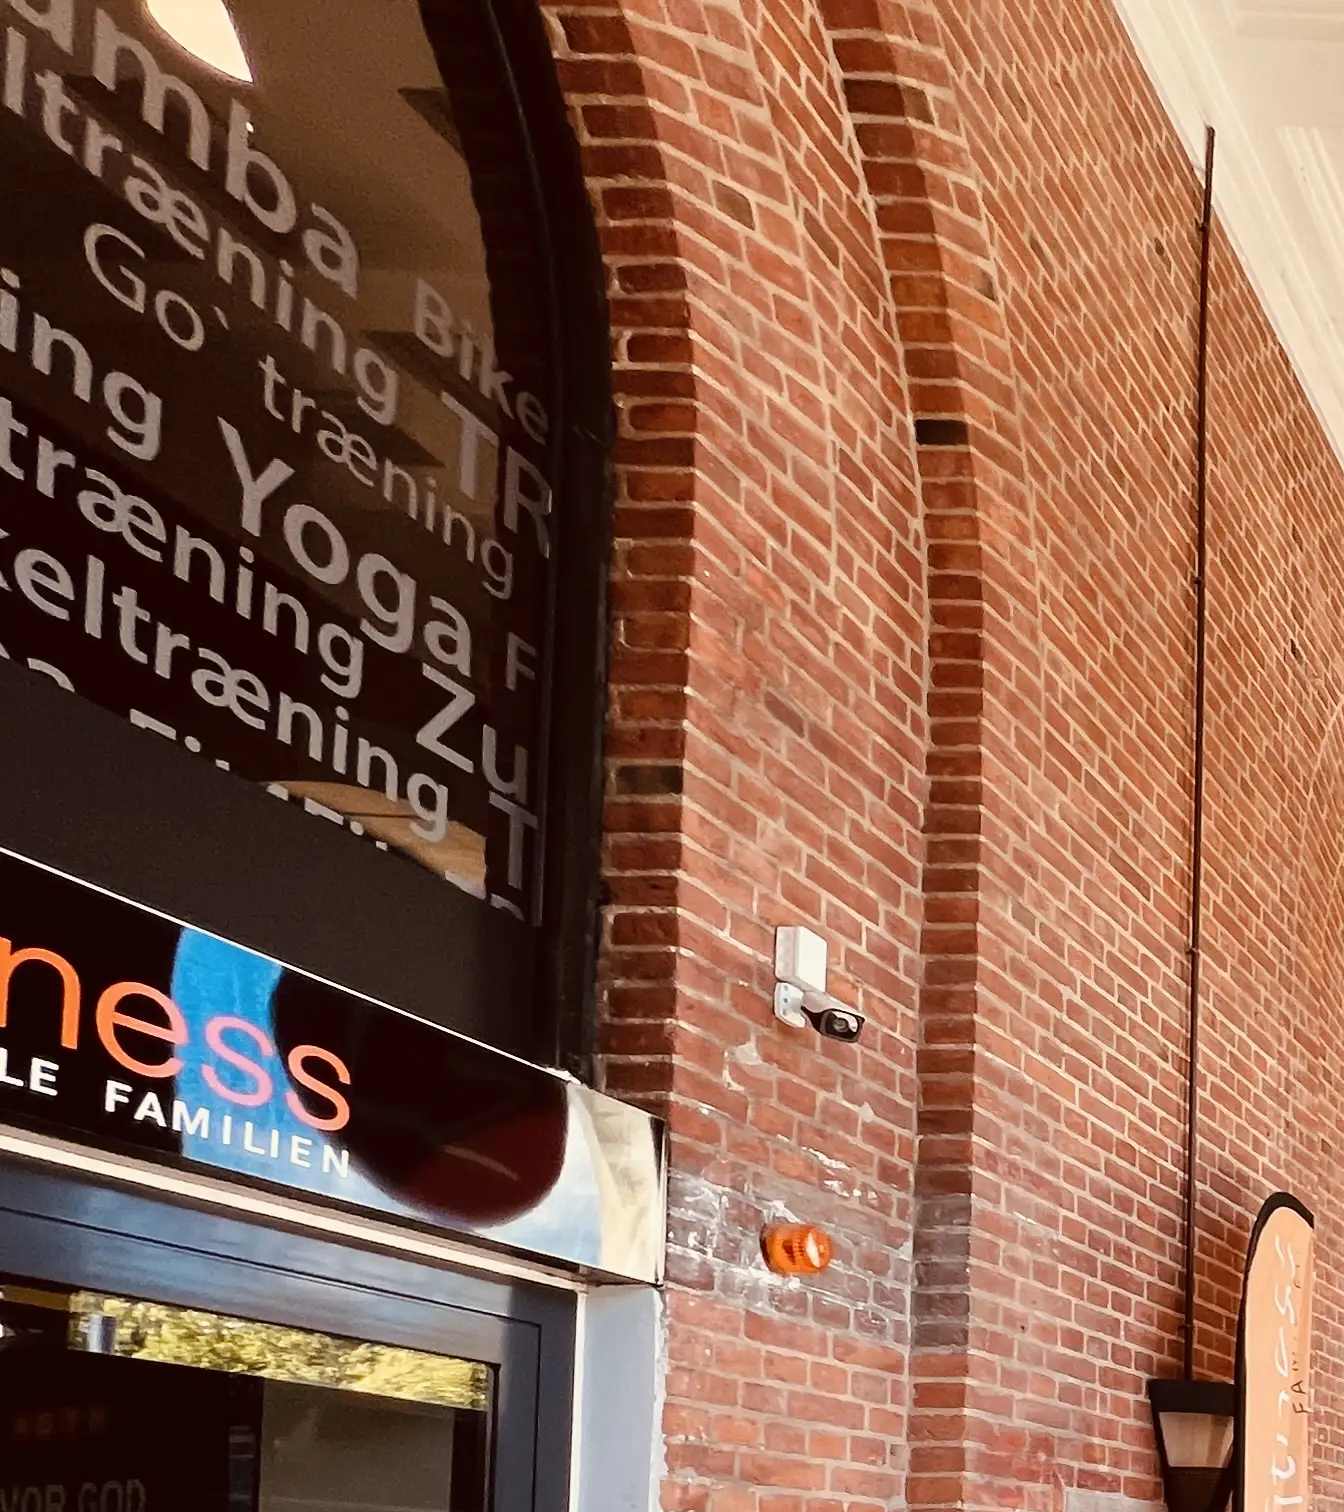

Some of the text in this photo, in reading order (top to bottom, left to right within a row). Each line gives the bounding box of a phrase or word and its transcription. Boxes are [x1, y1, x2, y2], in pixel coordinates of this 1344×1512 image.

[259, 354, 514, 600] træning
[414, 277, 548, 446] Bike
[218, 417, 473, 678] Yoga
[0, 528, 448, 842] eltræning
[104, 1079, 350, 1178] FAMILIEN
